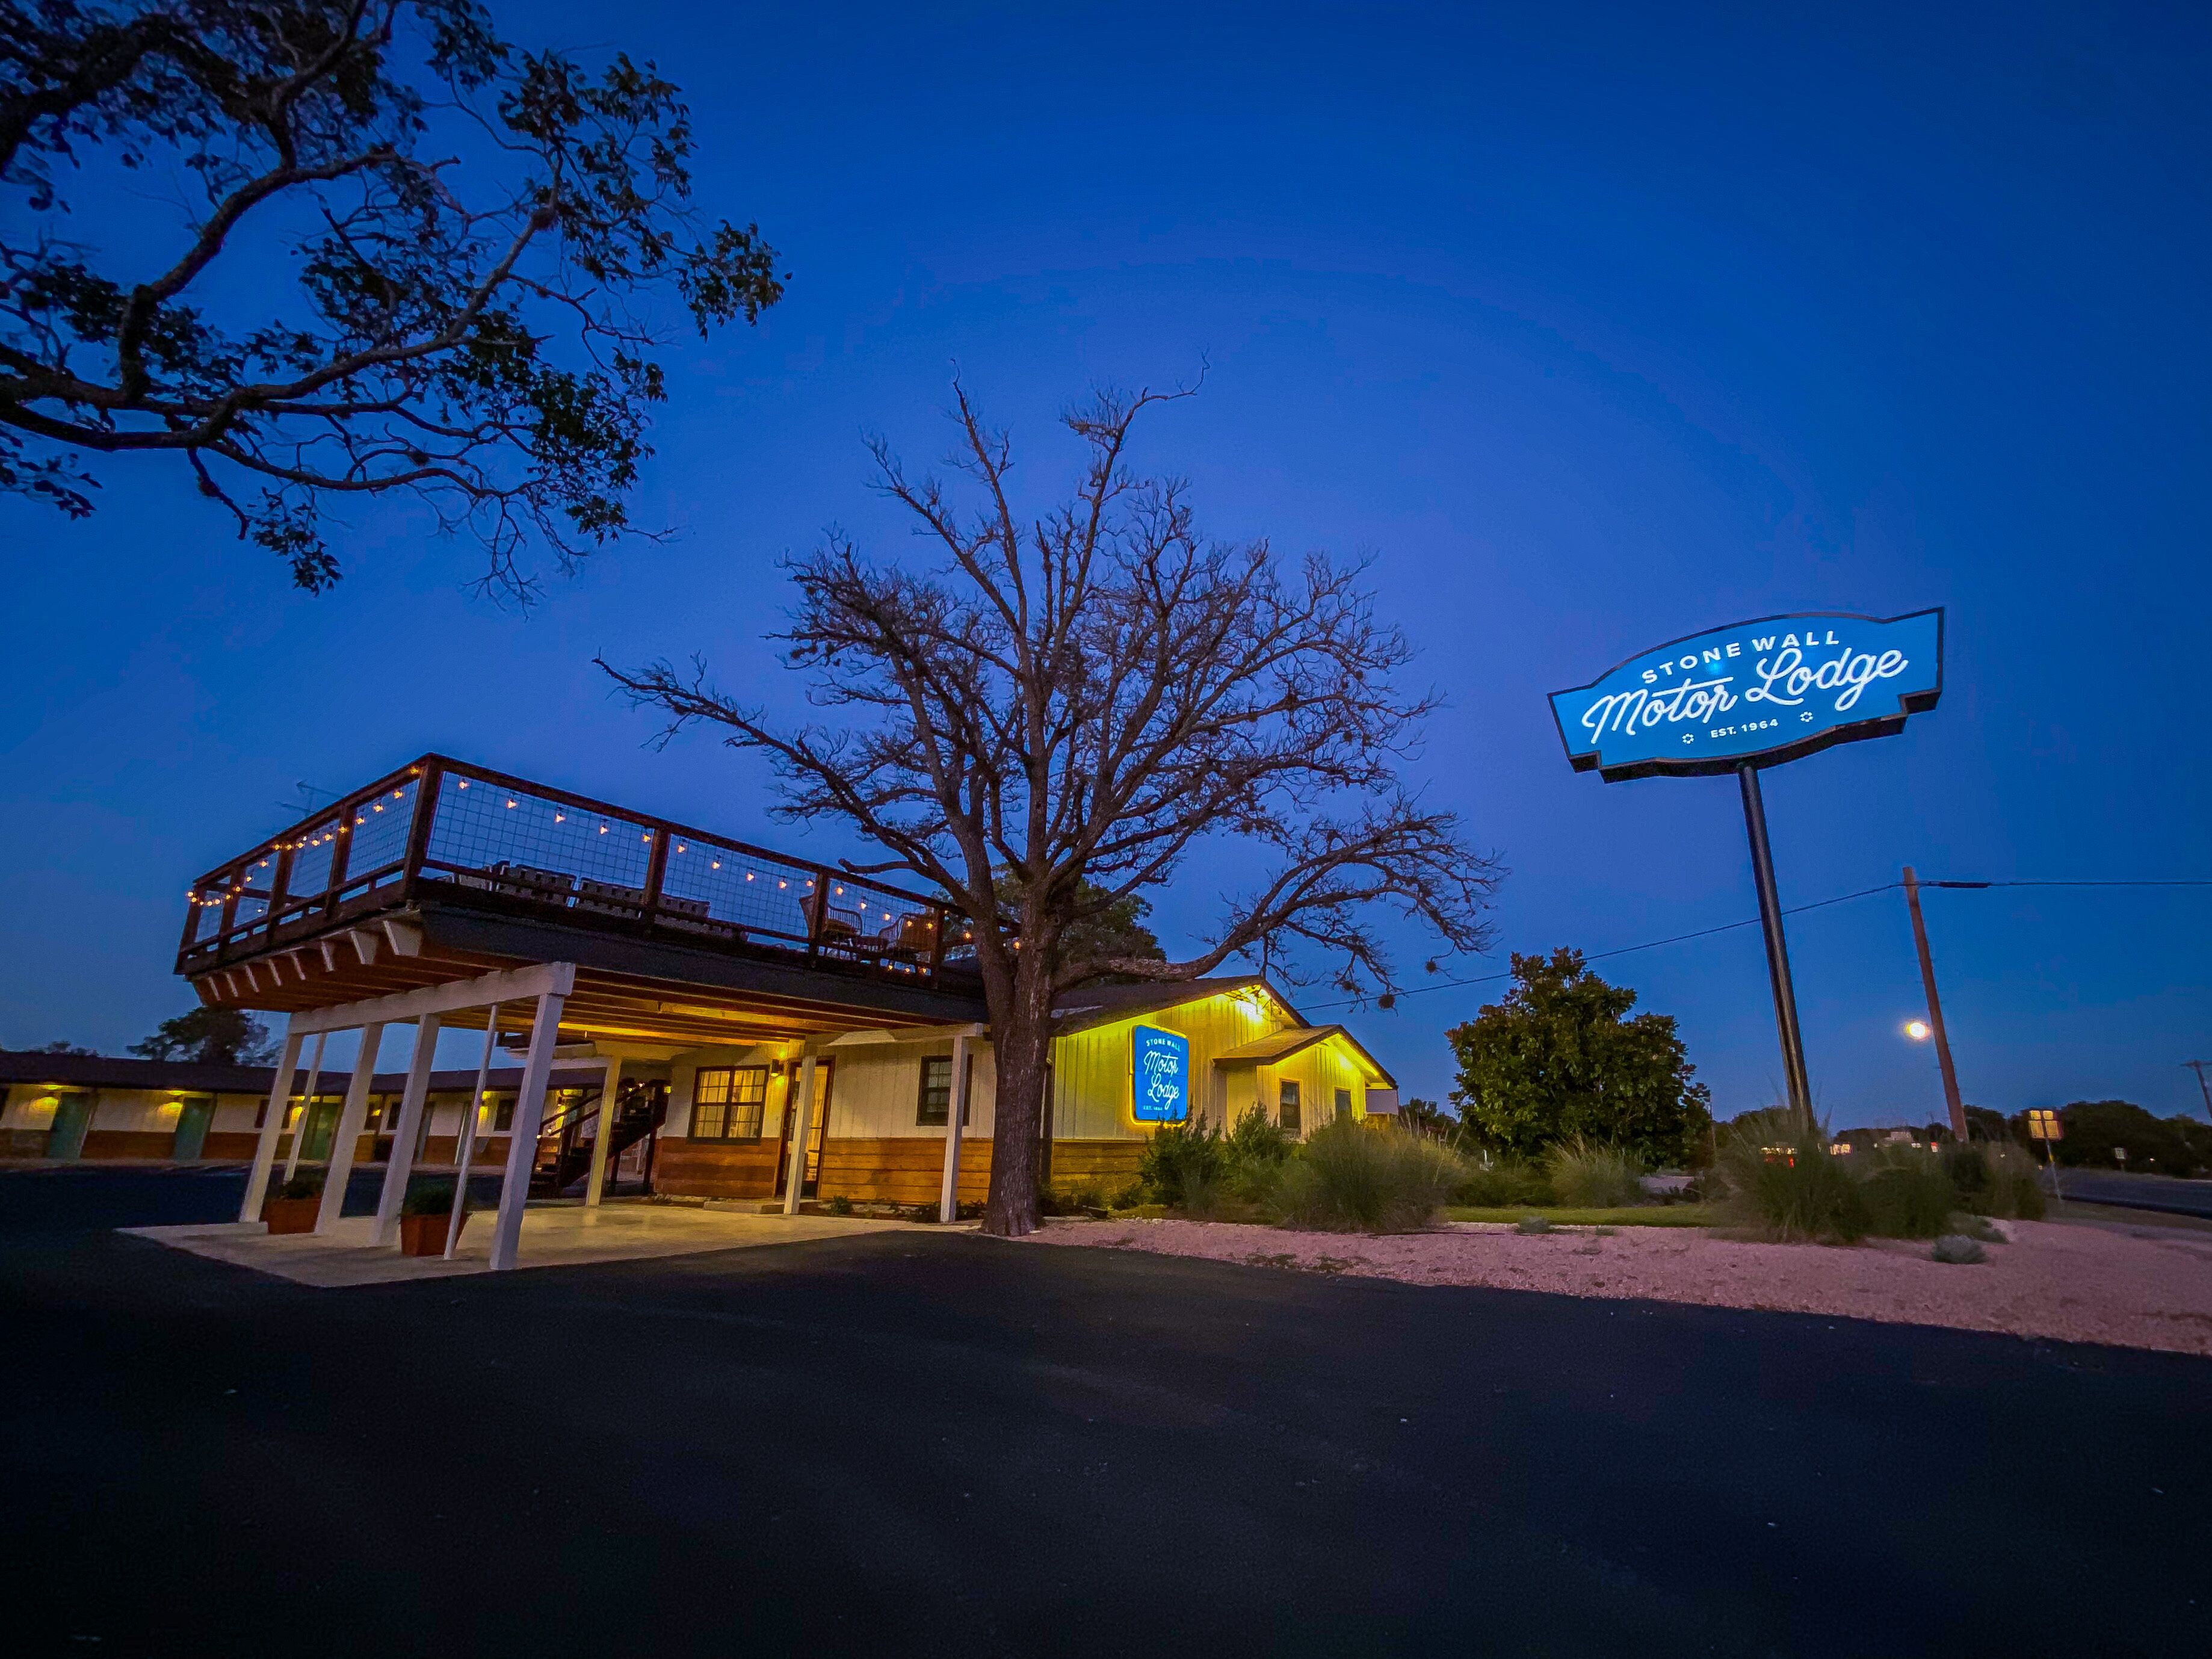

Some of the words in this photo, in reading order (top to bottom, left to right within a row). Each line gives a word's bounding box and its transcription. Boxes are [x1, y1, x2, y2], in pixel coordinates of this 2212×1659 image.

[1642, 642, 1741, 684] STONE
[1752, 631, 1840, 651] WALL
[1581, 676, 1738, 744] Motor
[1745, 647, 1909, 711] Lodge
[1710, 726, 1737, 738] EST.
[1741, 718, 1779, 732] 1964
[1143, 1050, 1179, 1077] Motor
[1148, 1073, 1179, 1110] Lodge
